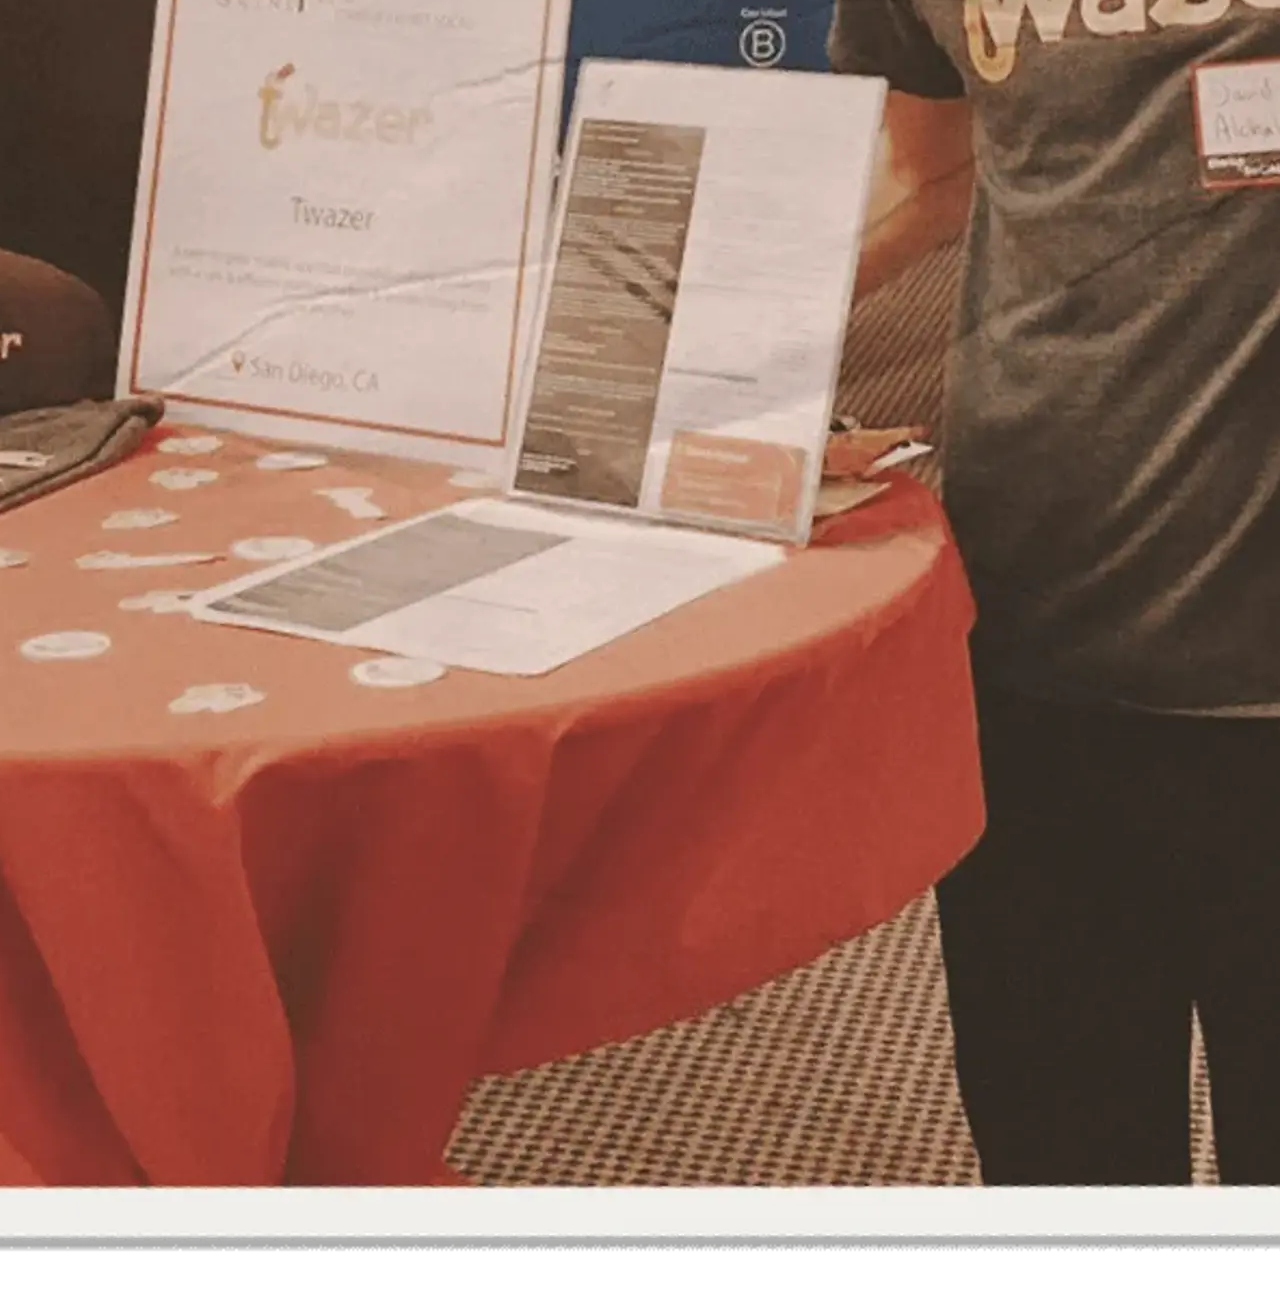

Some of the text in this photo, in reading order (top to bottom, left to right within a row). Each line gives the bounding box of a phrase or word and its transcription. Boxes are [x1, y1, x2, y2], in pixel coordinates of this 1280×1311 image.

[258, 71, 436, 150] twazer
[290, 195, 376, 231] Twazer
[249, 356, 285, 383] San
[352, 371, 380, 392] CA
